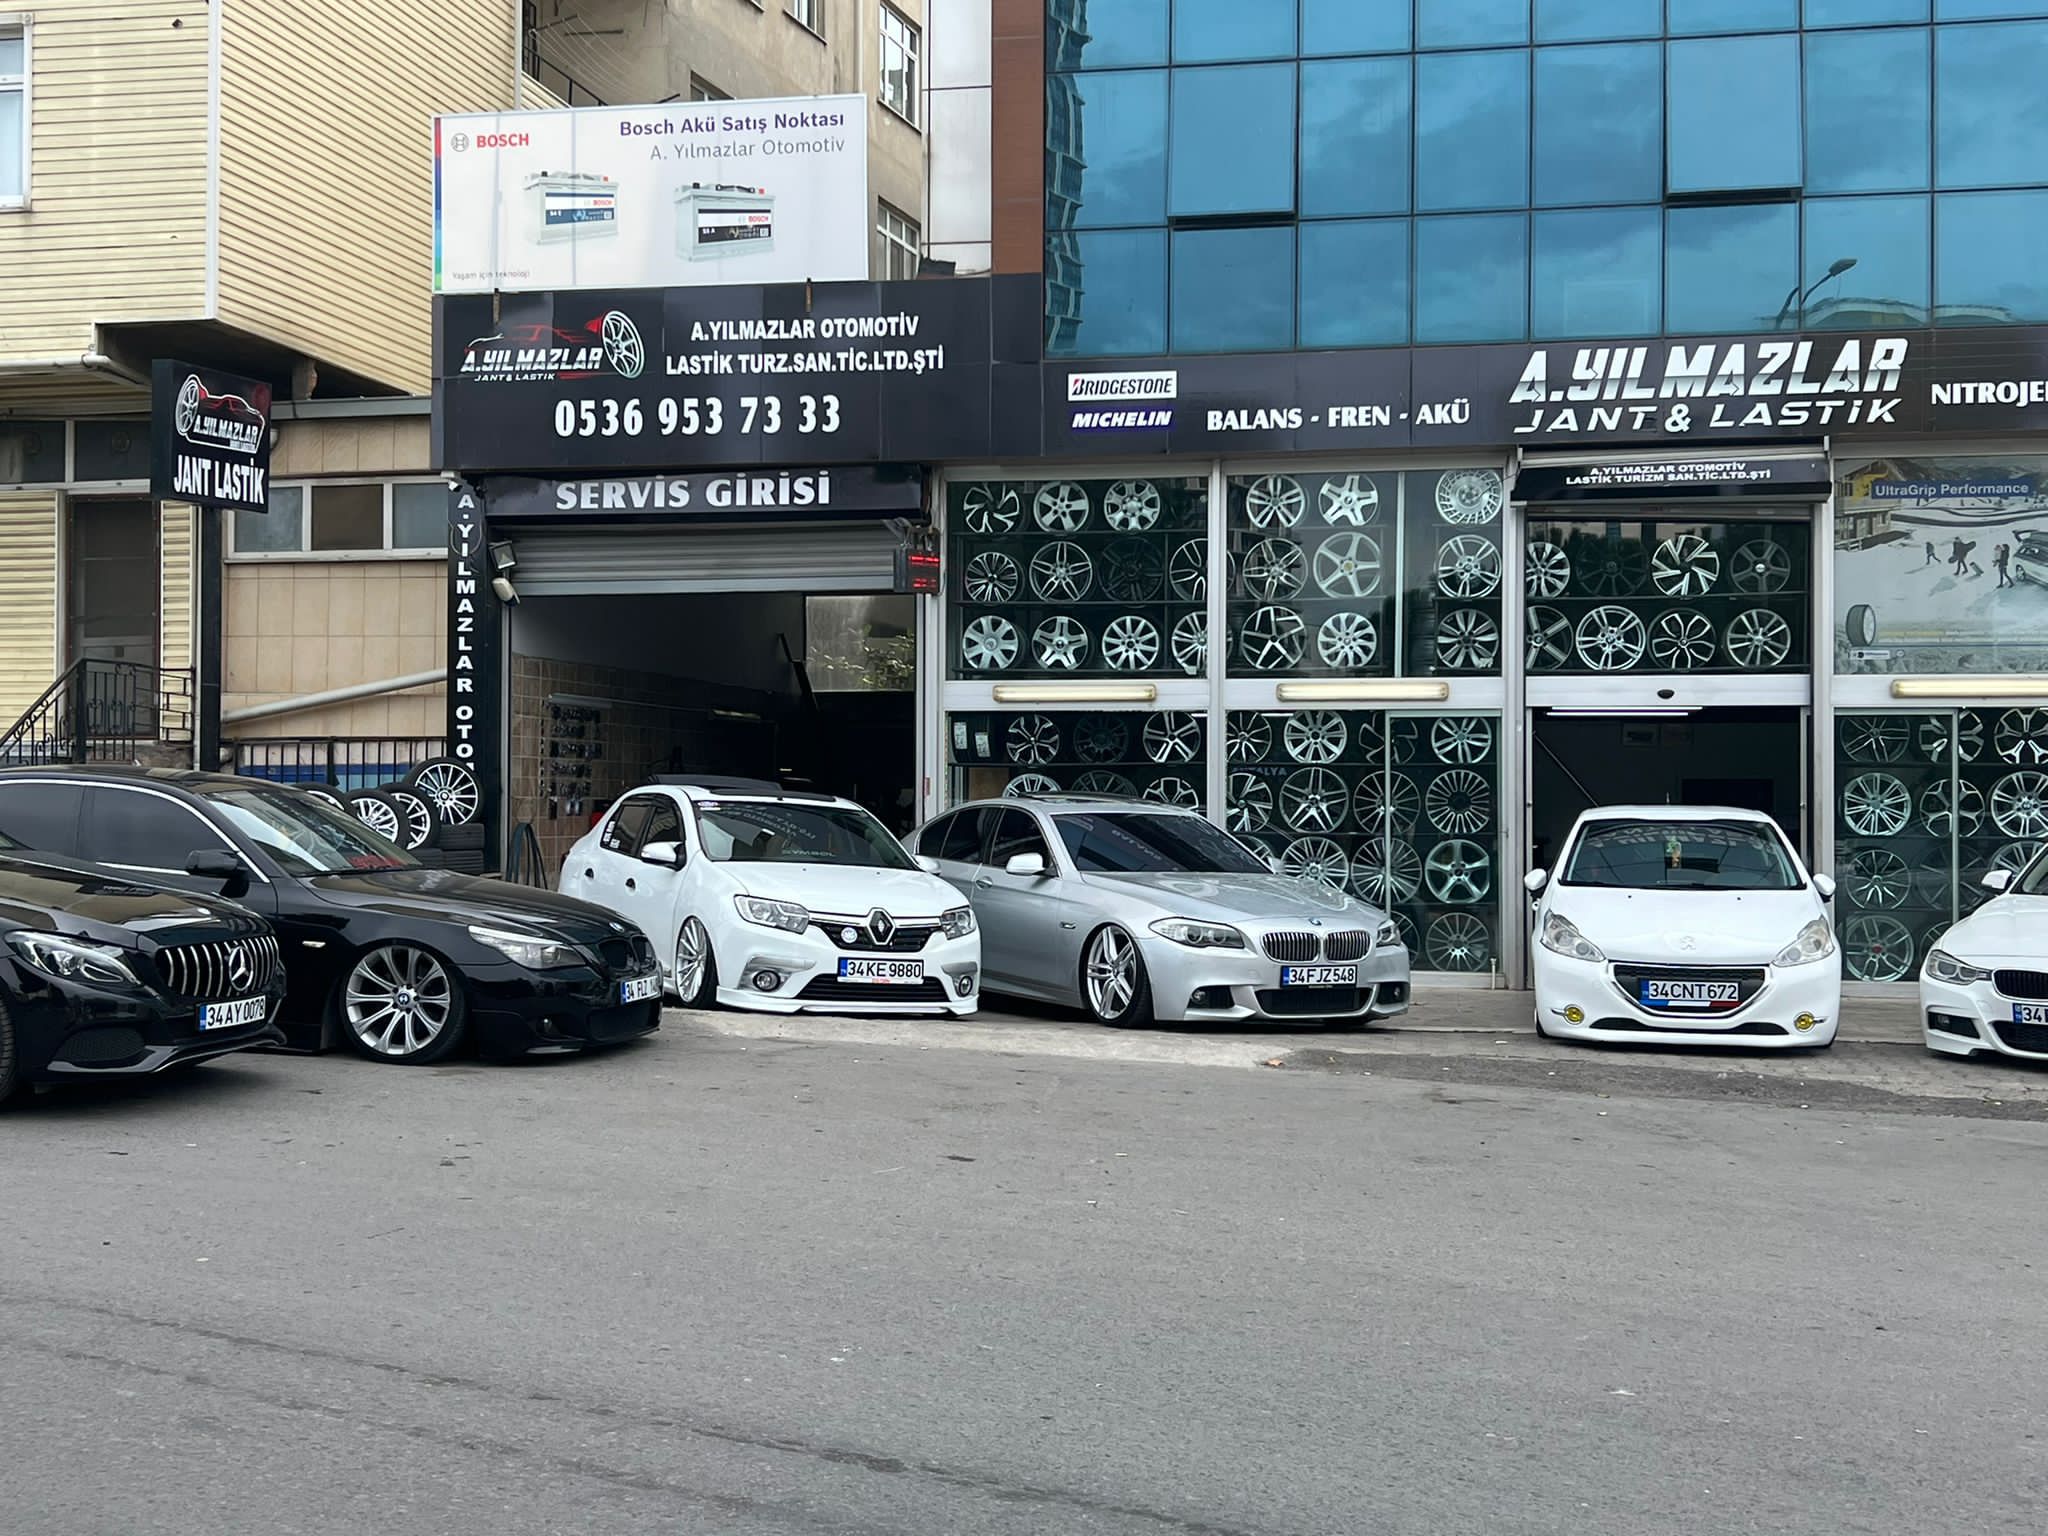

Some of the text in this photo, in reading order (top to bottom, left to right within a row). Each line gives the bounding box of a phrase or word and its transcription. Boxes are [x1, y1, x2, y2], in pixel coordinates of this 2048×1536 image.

[620, 112, 844, 136] Bosch Akü Satış Noktası
[476, 133, 529, 149] BOSCH
[650, 136, 845, 161] A. Yılmazlar Otomotiv
[748, 215, 769, 223] BOSCH
[691, 312, 920, 342] A.YILMAZLAR OTOMOTİV
[460, 348, 604, 372] A.YILMAZLAR
[666, 350, 733, 376] LASTİK
[1509, 338, 1909, 404] A.YILMAZLAR
[1072, 377, 1174, 396] BRIDGESTONE
[554, 395, 841, 438] 0536 953 73 33
[1071, 410, 1173, 429] MICHELIN
[1207, 408, 1303, 431] BALANS
[1327, 405, 1391, 428] FREN
[1415, 398, 1471, 425] AKÜ
[1513, 405, 1657, 434] JANT
[1664, 402, 1691, 432] &
[173, 454, 265, 505] JANT LASTİK
[1566, 475, 1612, 485] LASTİK
[1615, 472, 1665, 483] TURİZM
[1590, 462, 1746, 476] A.YILMAZLAR OTOMOTİV
[555, 475, 691, 511] SERVİS
[1875, 483, 2029, 497] UltraGrip Performance
[455, 705, 475, 771] OTO
[848, 961, 922, 978] 34 KE 9880
[1290, 967, 1355, 983] 34 FJZ 548
[1650, 983, 1737, 999] 34 CNT 672
[207, 1005, 224, 1027] 34
[225, 1003, 242, 1024] AY
[2022, 1006, 2042, 1022] 34
